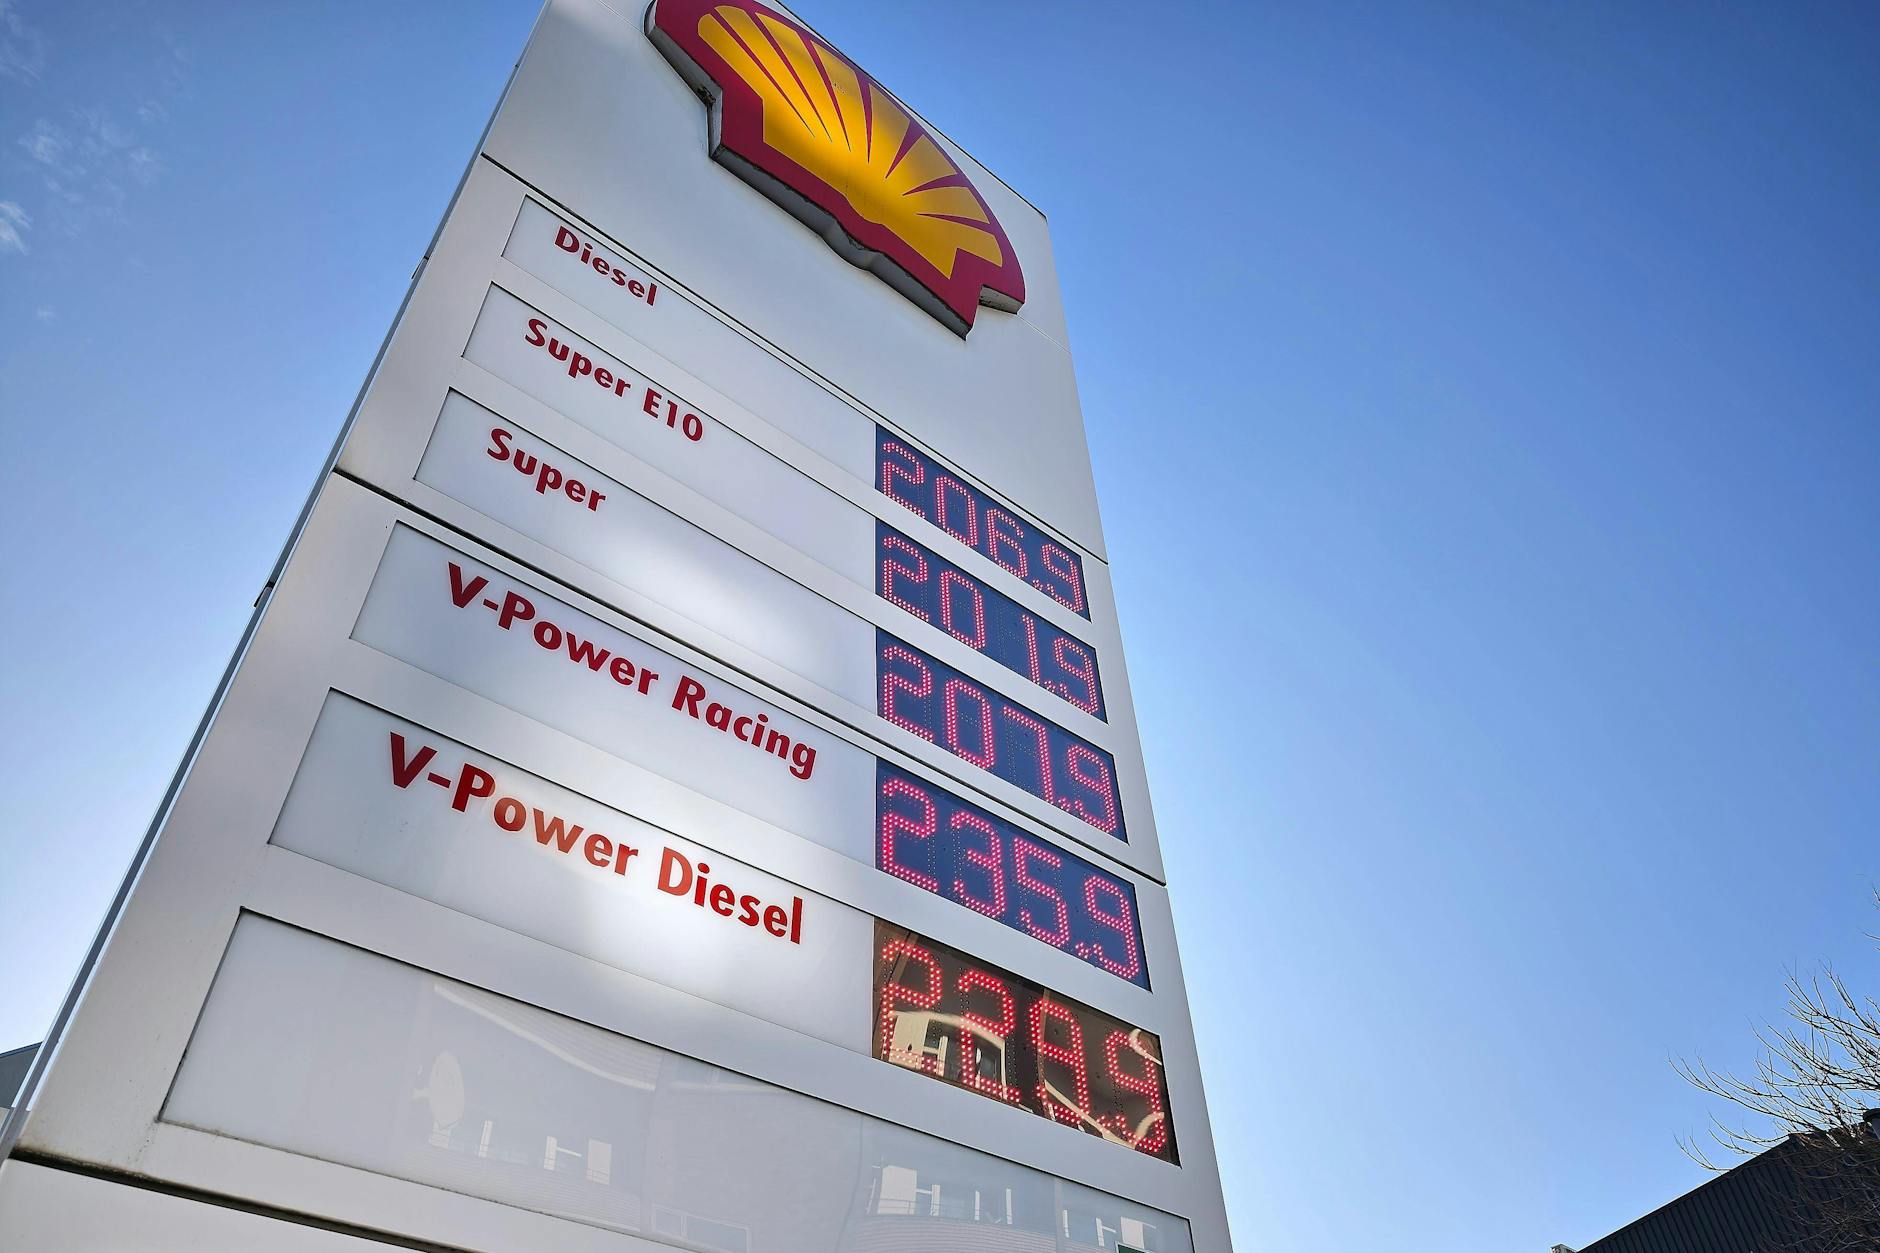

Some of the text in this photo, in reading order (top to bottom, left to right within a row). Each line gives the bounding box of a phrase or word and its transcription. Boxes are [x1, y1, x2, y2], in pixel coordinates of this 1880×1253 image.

[554, 226, 657, 305] Diesel
[526, 318, 704, 443] Super E10
[488, 426, 607, 512] Super
[447, 562, 818, 781] V-Power Racing
[390, 731, 804, 946] V-Power Diesel
